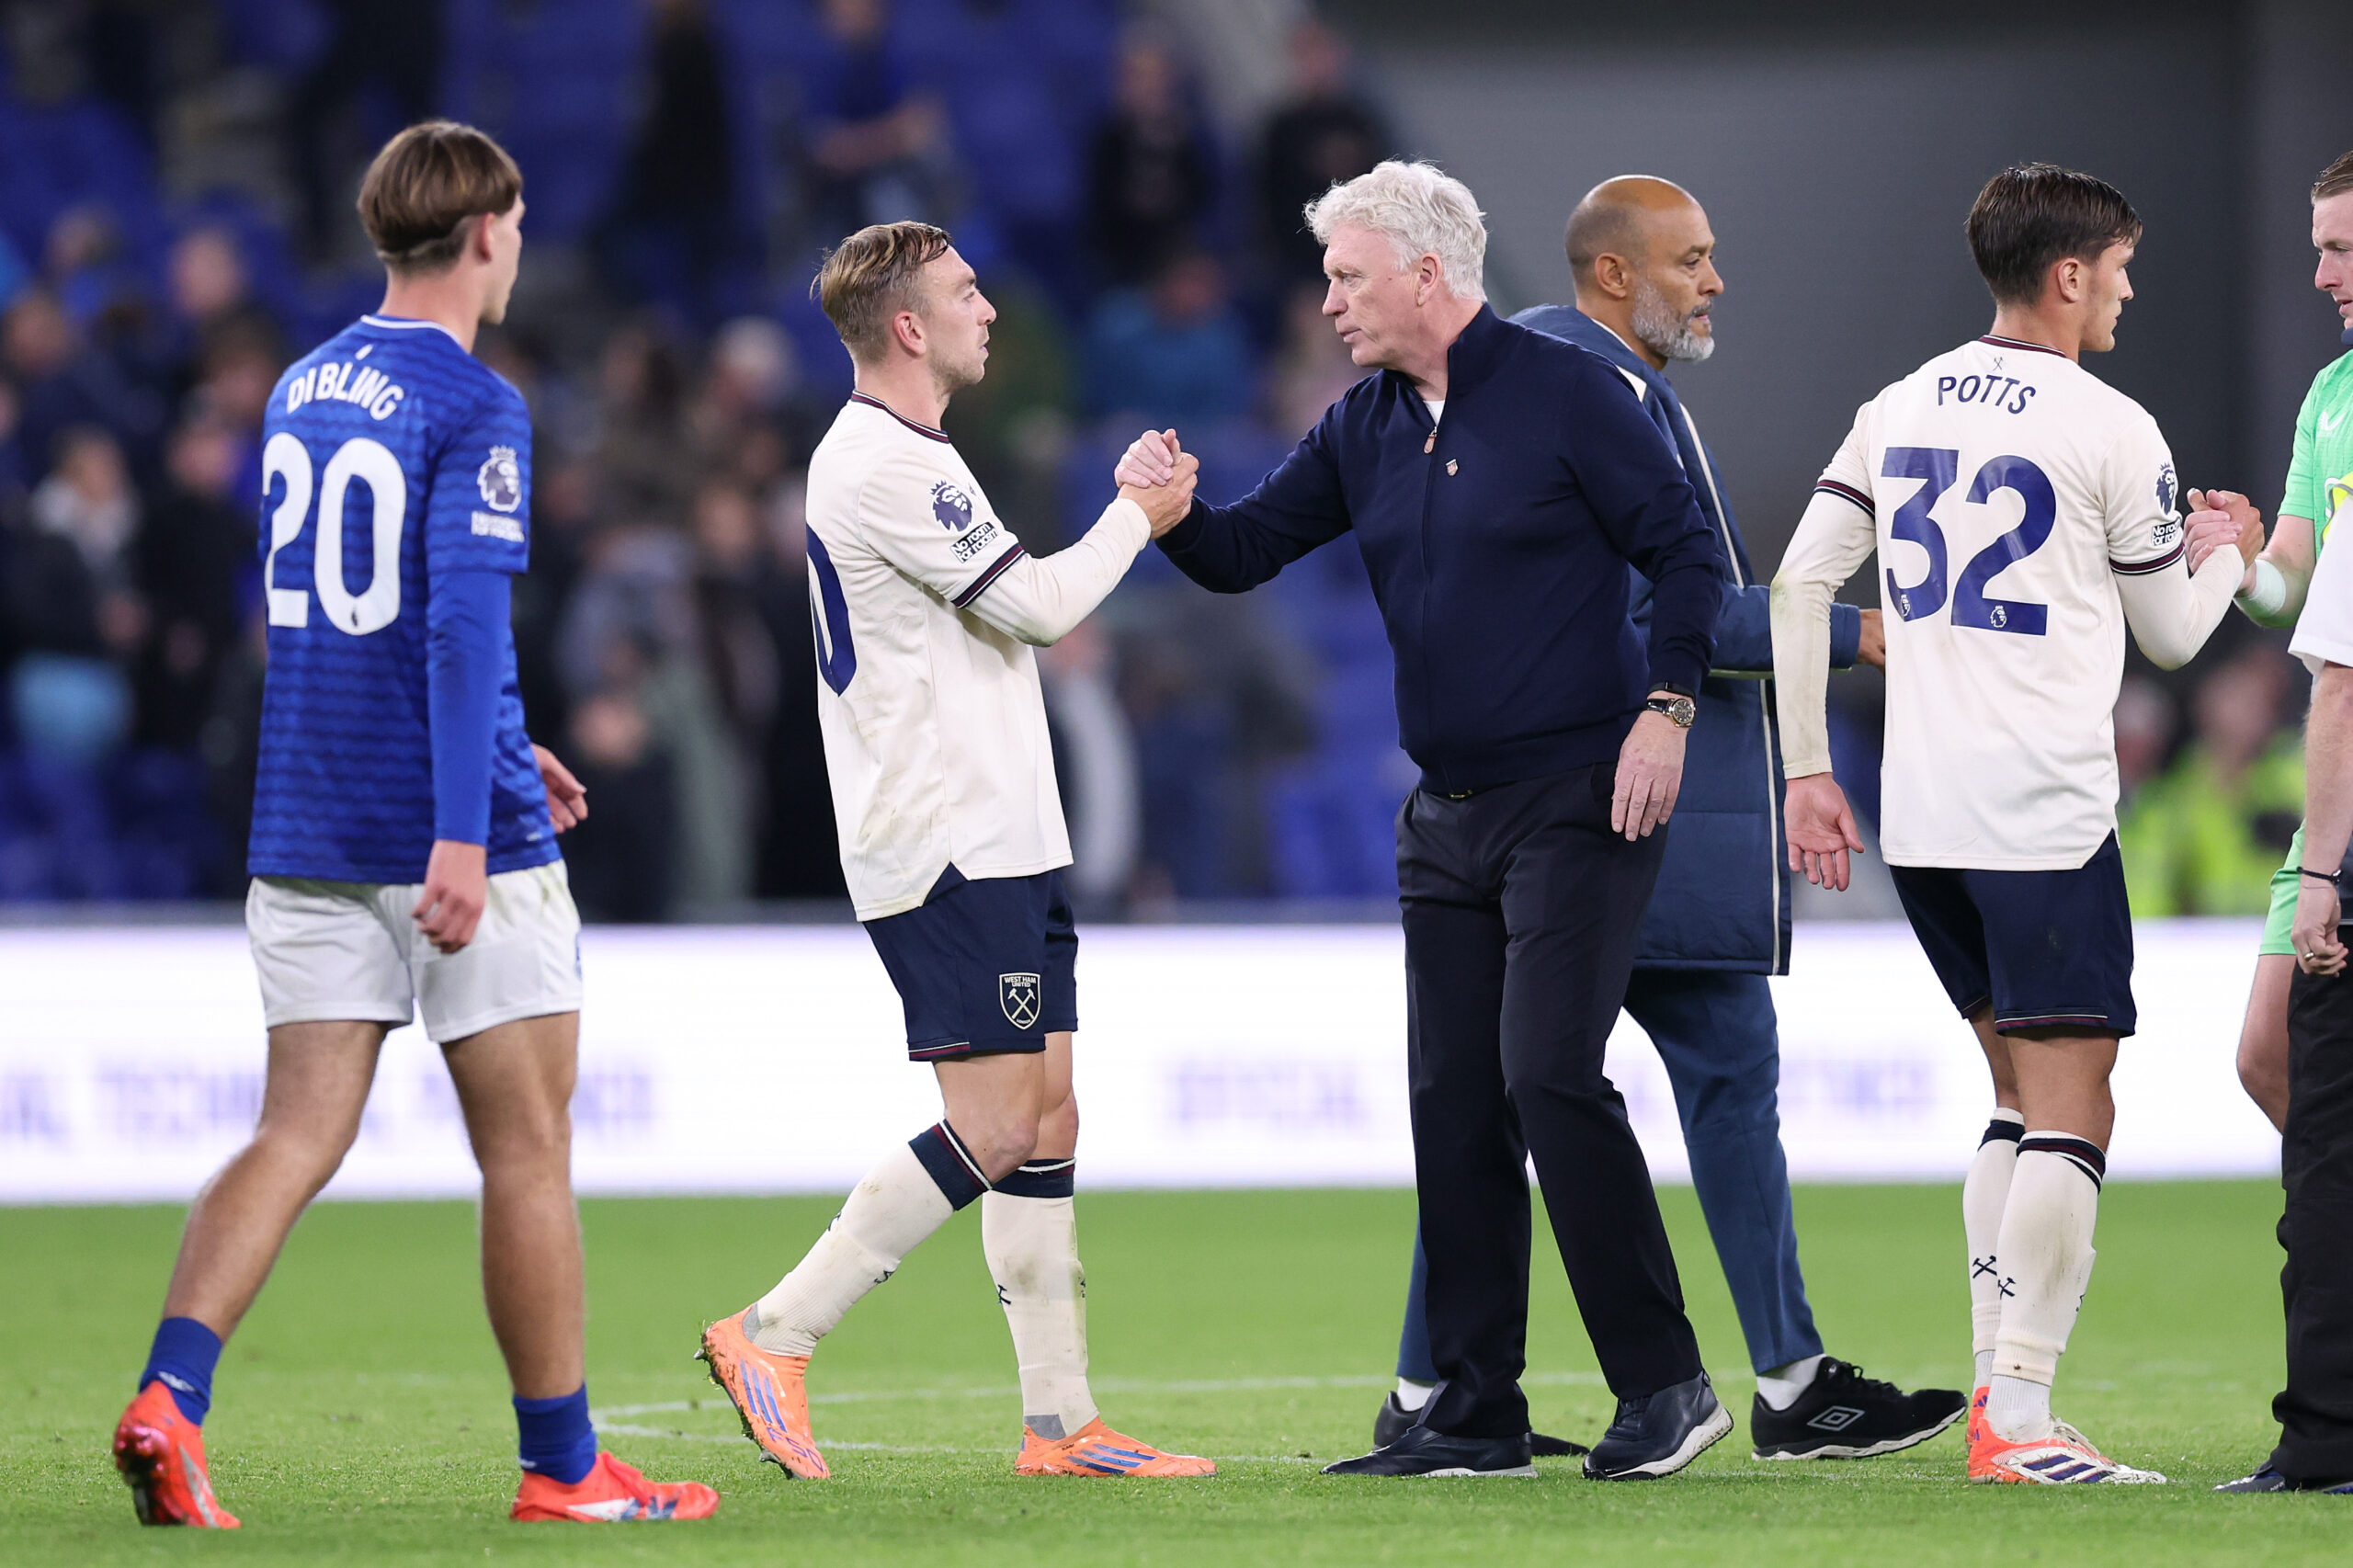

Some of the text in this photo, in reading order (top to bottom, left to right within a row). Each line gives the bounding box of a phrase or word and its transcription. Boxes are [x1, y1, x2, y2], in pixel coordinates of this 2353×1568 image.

[287, 361, 404, 421] DIBLING
[1938, 374, 2036, 415] POTTS
[262, 431, 406, 636] 20
[950, 524, 991, 555] No room
[1881, 447, 2057, 636] 32
[2152, 525, 2165, 537] No
